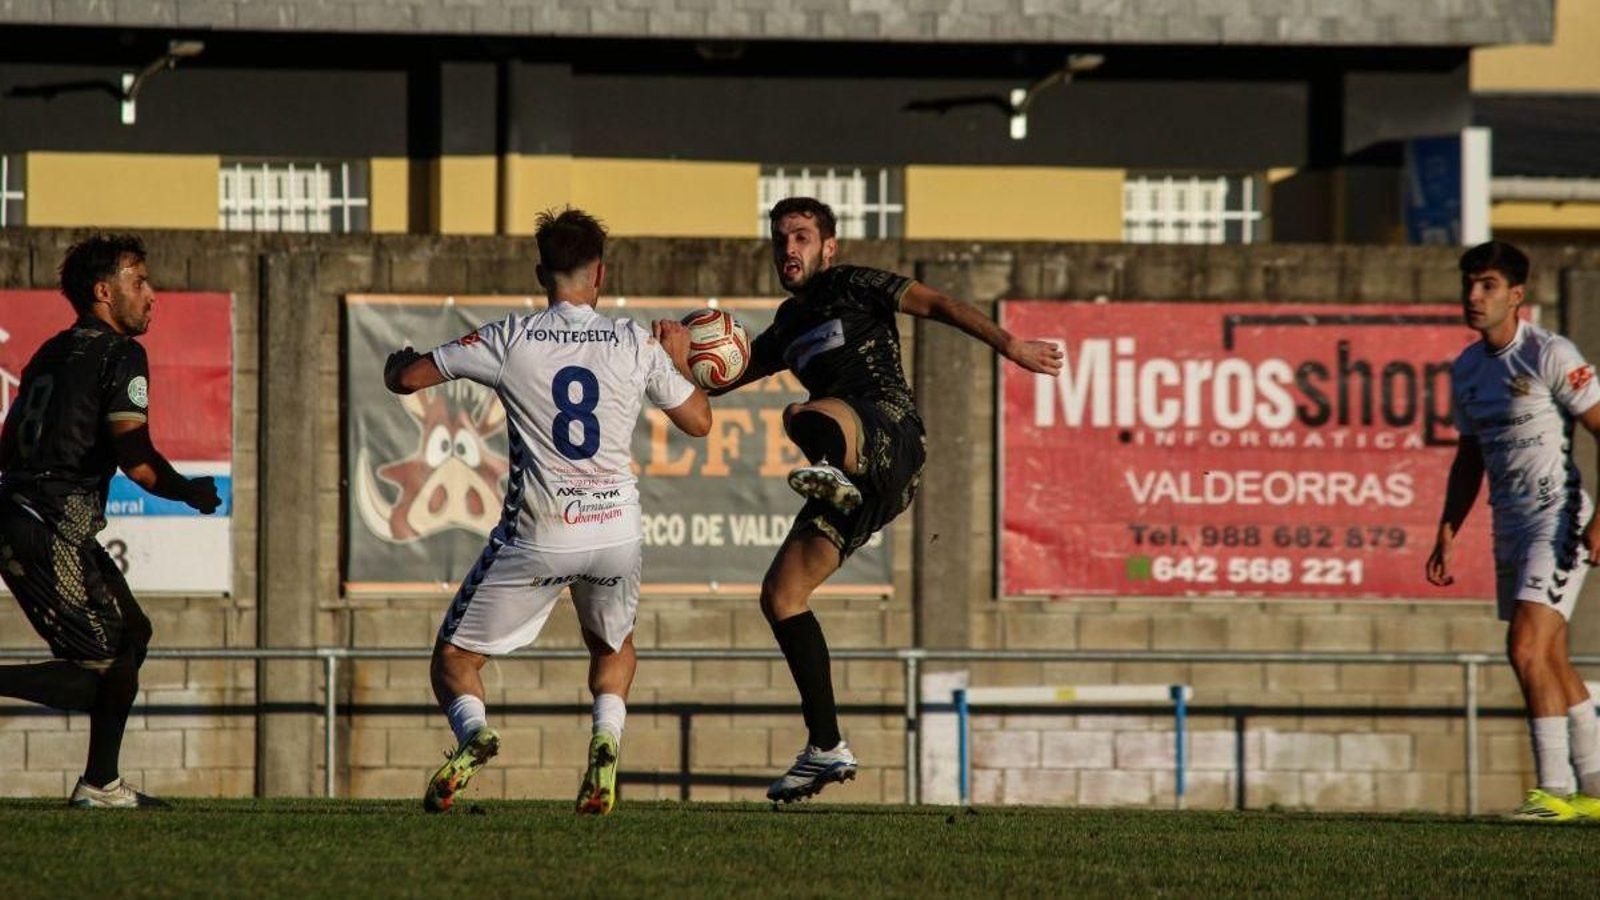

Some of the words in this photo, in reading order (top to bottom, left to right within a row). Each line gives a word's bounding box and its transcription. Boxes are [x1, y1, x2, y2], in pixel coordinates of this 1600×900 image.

[526, 329, 619, 347] FONTECELTA
[552, 366, 600, 460] 8
[632, 409, 812, 478] LFE
[1135, 430, 1424, 448] INFORMATICA
[1124, 470, 1415, 507] VALDEORRAS
[640, 513, 686, 546] RCO
[691, 513, 724, 546] DE
[728, 513, 798, 546] VALD
[1129, 525, 1188, 547] Tel.
[1201, 526, 1261, 548] 988
[1272, 526, 1332, 548] 682
[1345, 527, 1407, 548] 879
[1151, 556, 1218, 583] 642
[1227, 557, 1292, 583] 568
[1301, 559, 1364, 585] 221
